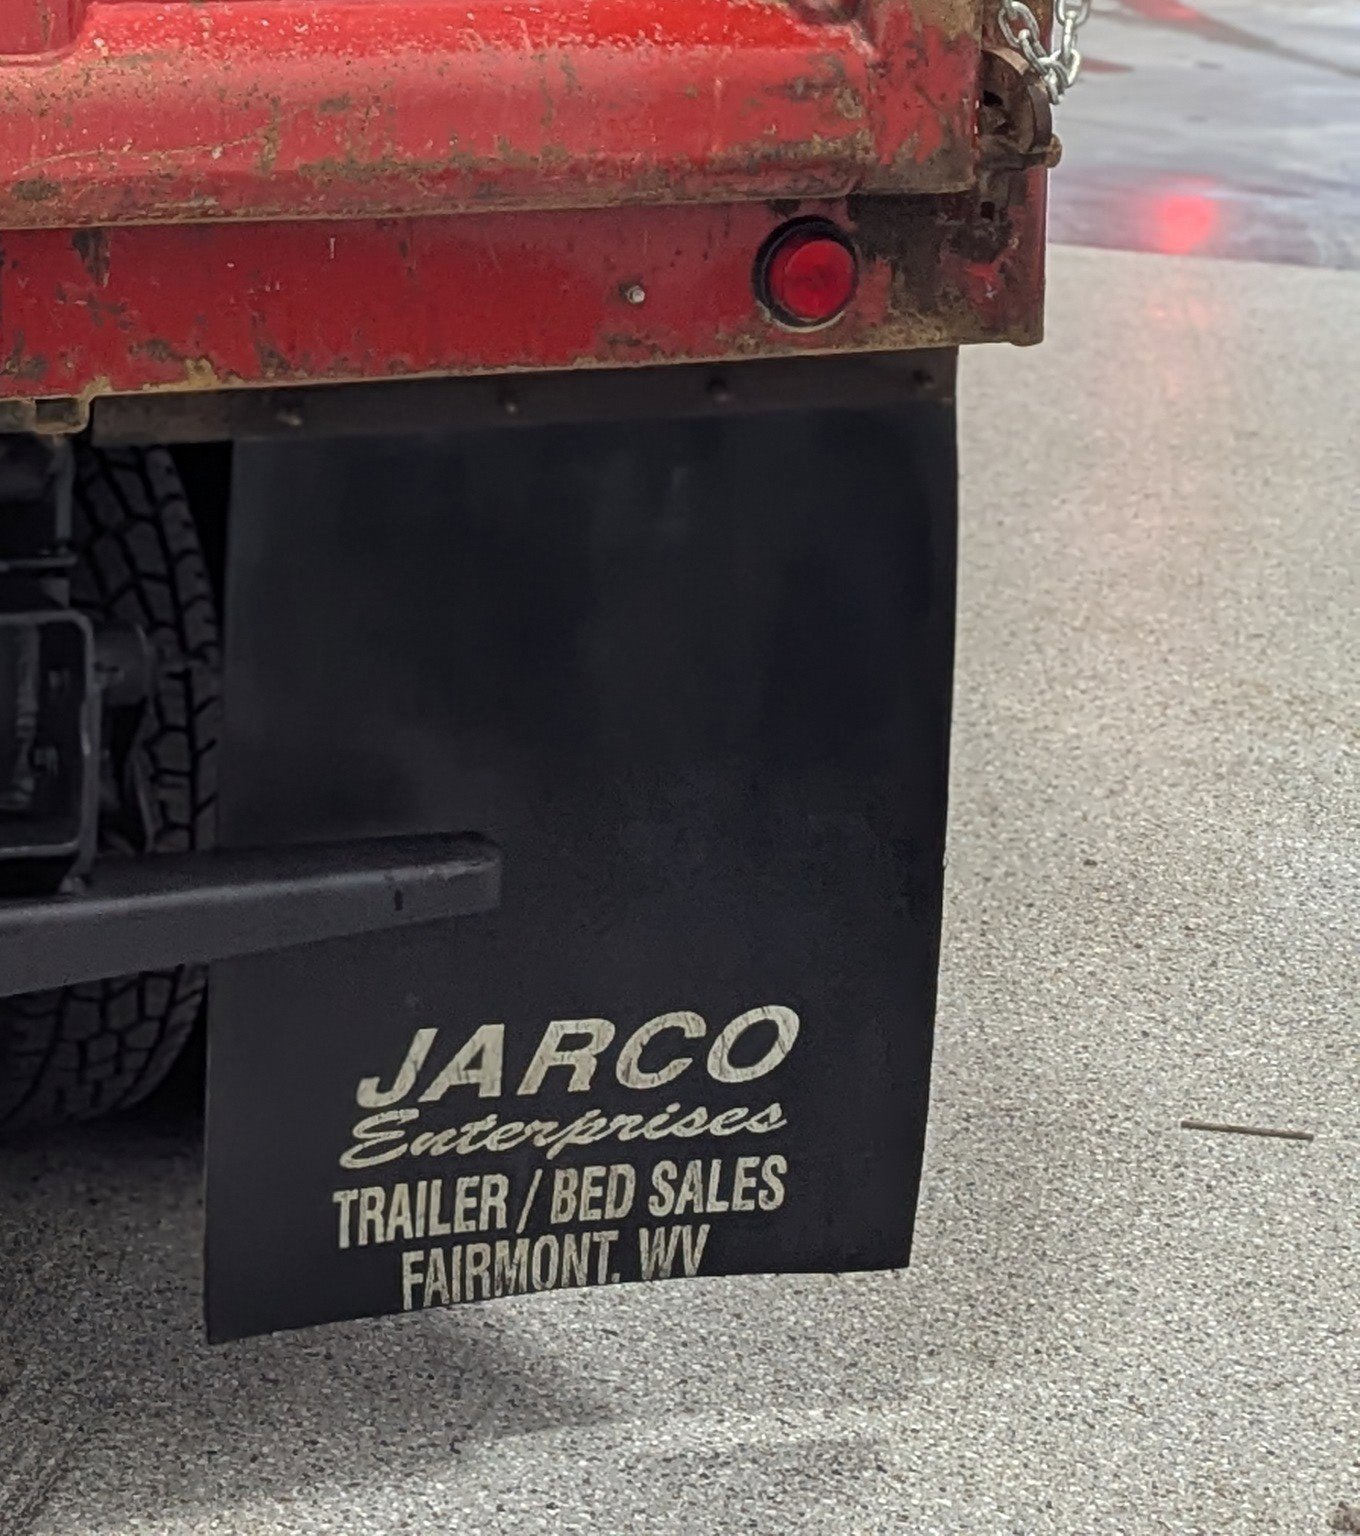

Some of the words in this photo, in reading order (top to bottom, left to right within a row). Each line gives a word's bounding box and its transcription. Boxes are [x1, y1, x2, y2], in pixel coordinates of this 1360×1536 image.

[356, 1004, 800, 1109] JARCO
[339, 1101, 788, 1169] Enterprises
[332, 1173, 509, 1249] TRAILER
[550, 1163, 636, 1225] BED
[647, 1154, 788, 1217] SALES
[638, 1223, 711, 1280] WV
